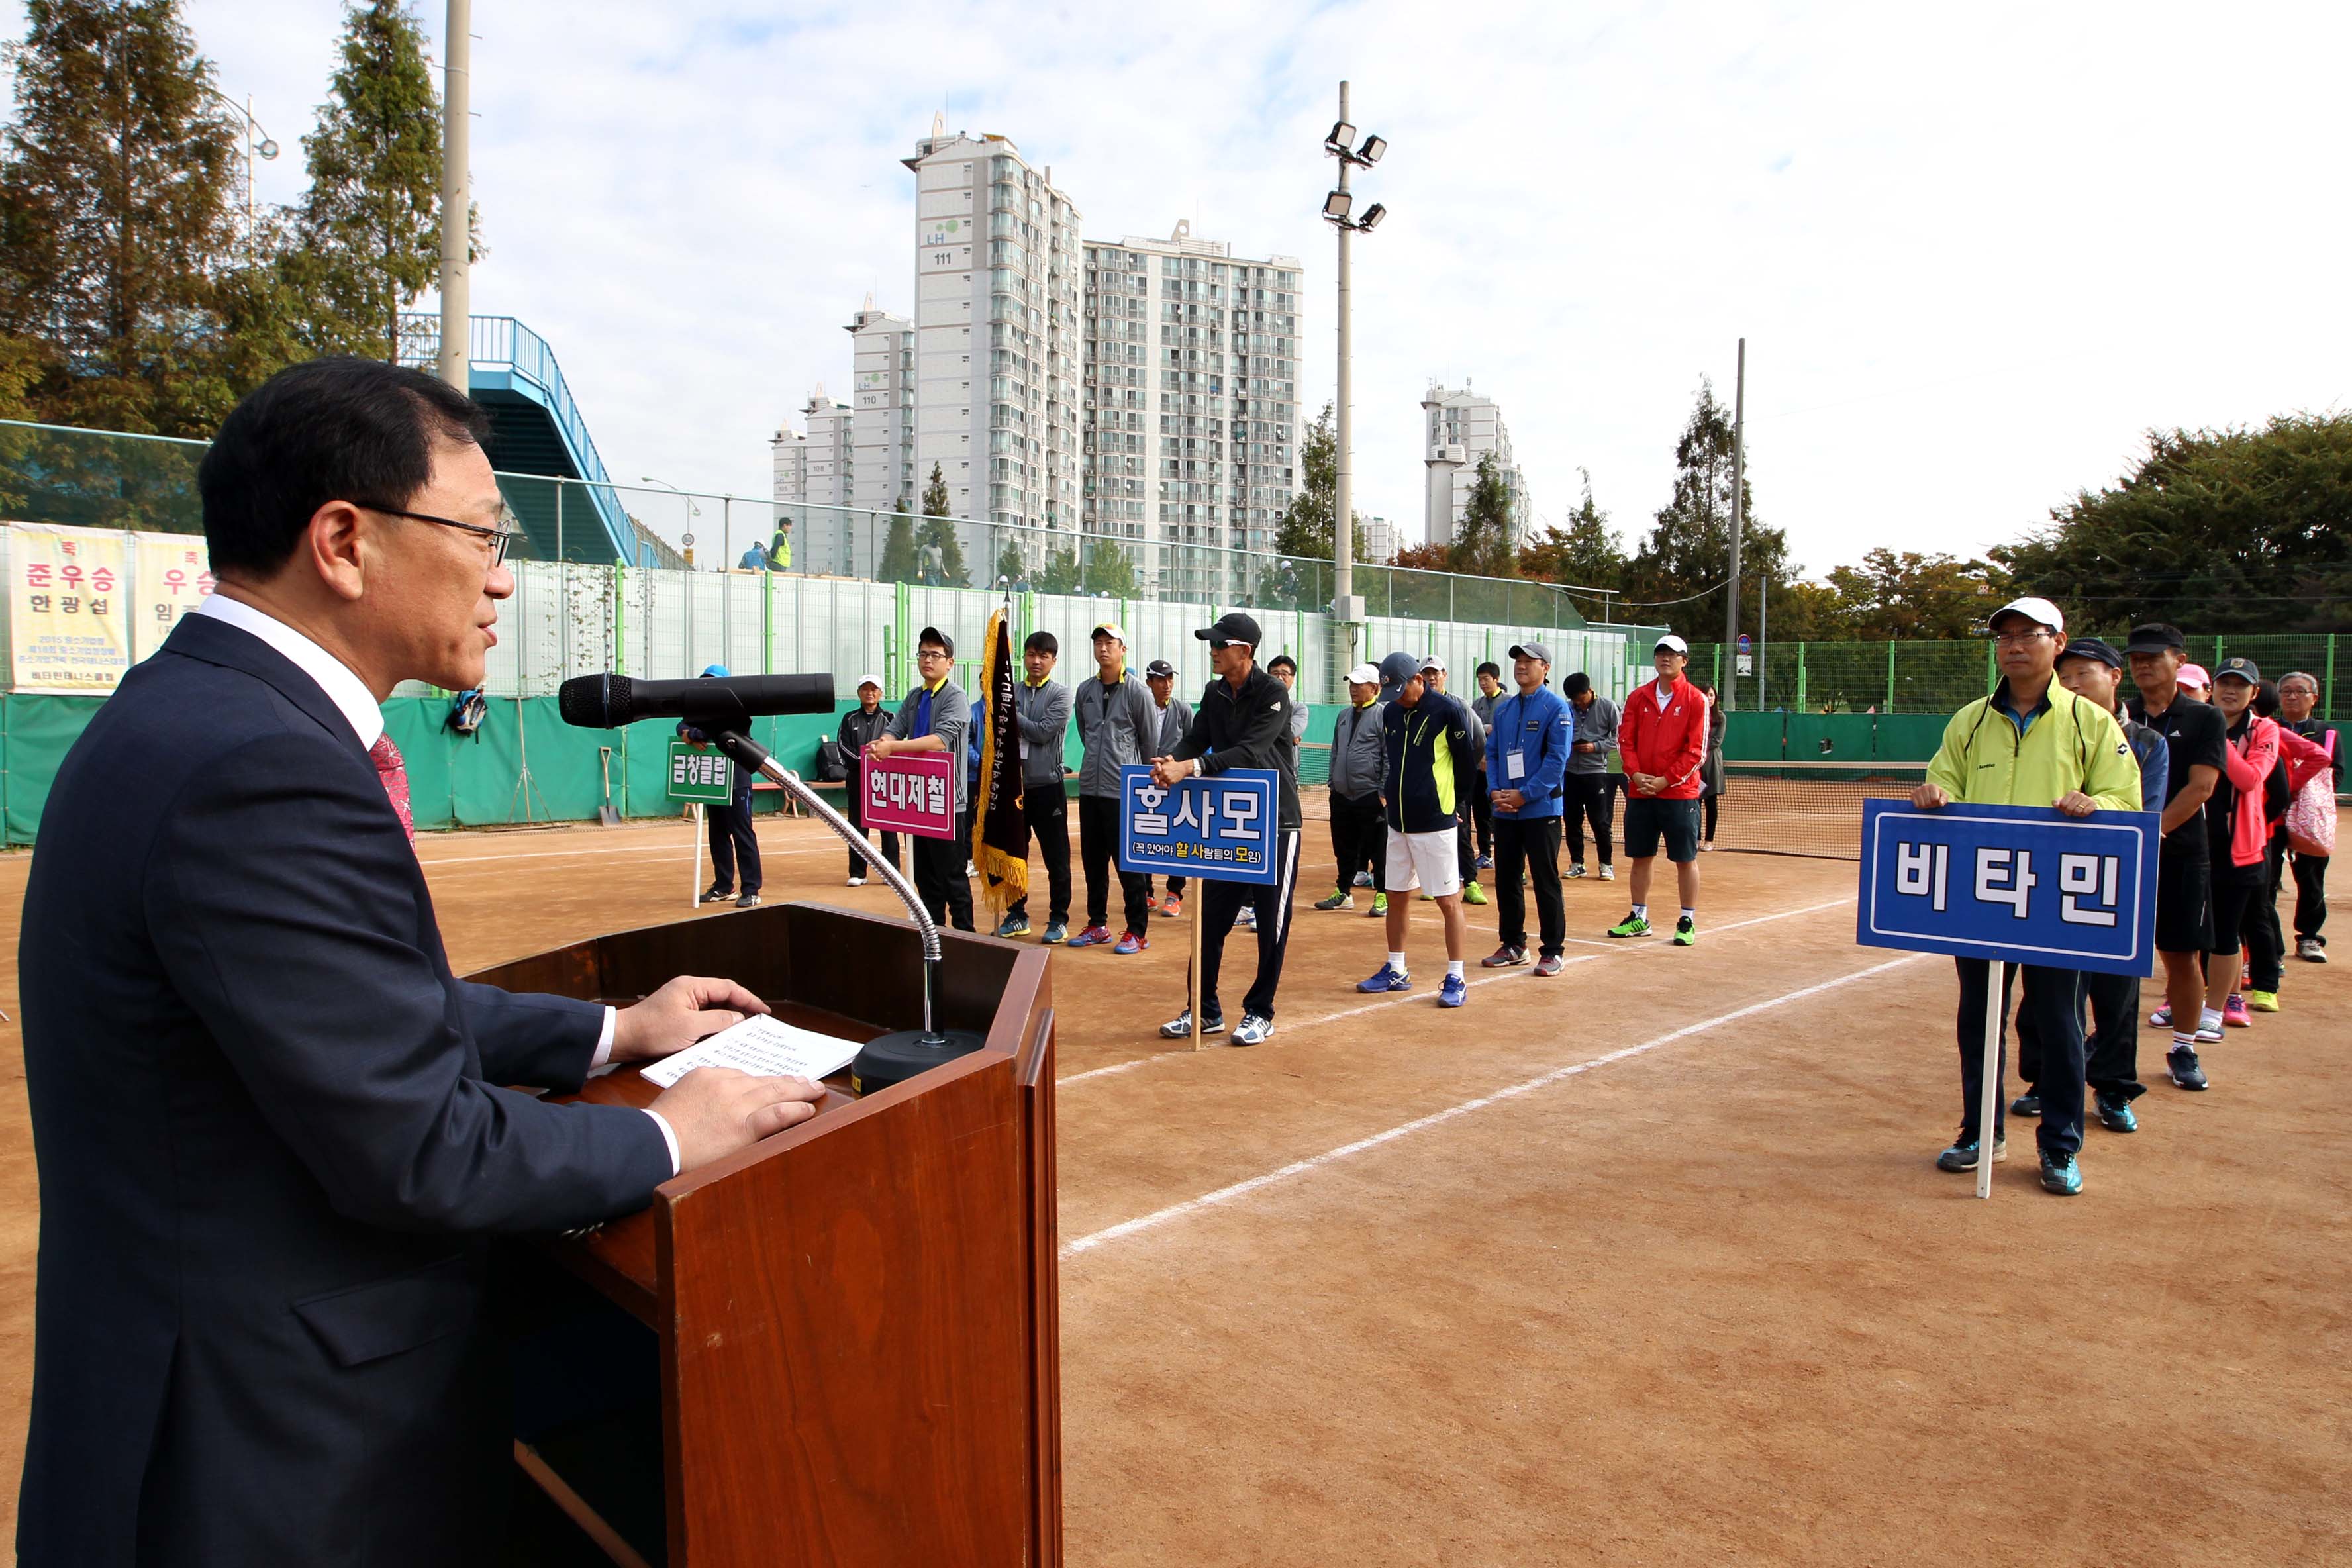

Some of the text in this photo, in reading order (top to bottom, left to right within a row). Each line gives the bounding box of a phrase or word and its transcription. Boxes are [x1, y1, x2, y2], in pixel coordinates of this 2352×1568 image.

[927, 233, 944, 244] LH
[934, 252, 951, 265] 111
[863, 395, 877, 405] 110
[61, 541, 76, 556] 축
[185, 551, 197, 565] 축
[26, 564, 115, 591] 준우승
[673, 754, 726, 785] 금창클럽
[870, 769, 946, 815] 현대제철
[1134, 784, 1261, 840] 홀사모
[1132, 842, 1261, 863] (꼭 있어야 할 사람들의 모임)
